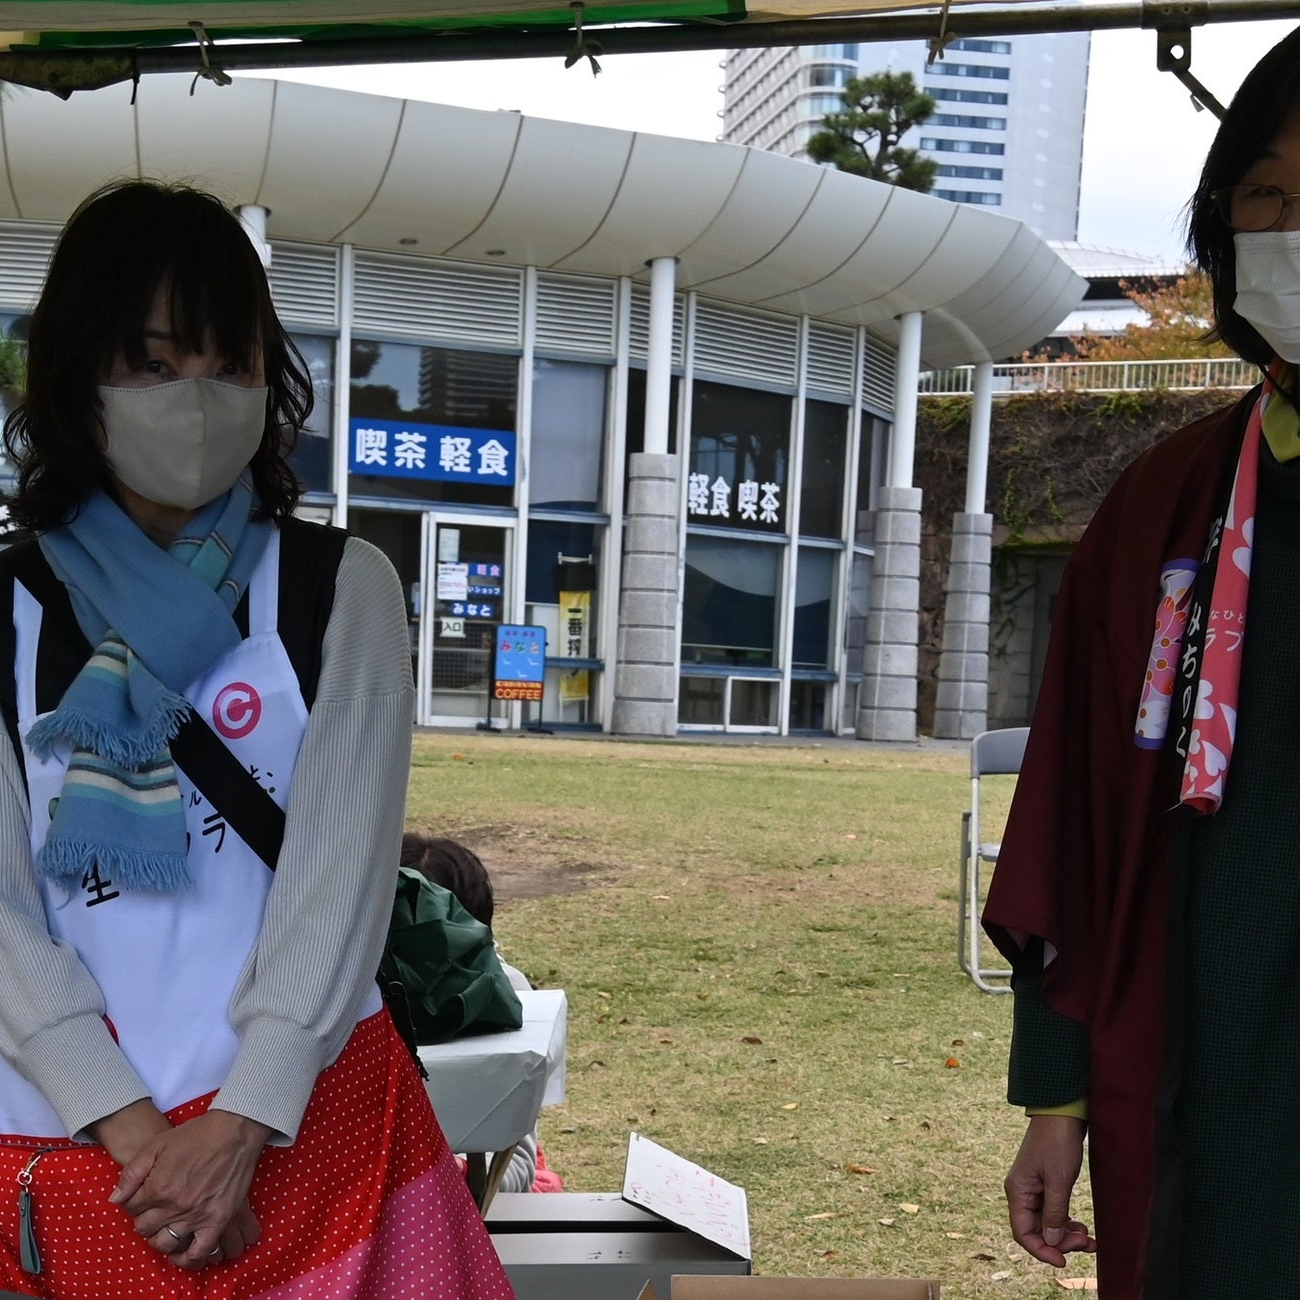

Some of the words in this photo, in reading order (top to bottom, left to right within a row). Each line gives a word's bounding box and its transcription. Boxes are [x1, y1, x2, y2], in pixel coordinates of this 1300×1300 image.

[356, 429, 427, 469] 喫茶
[439, 435, 509, 476] 軽食
[688, 472, 731, 518] 軽食
[738, 479, 780, 523] 喫茶
[453, 603, 492, 617] みなと
[443, 621, 462, 632] 入口
[495, 689, 541, 700] COFFEE
